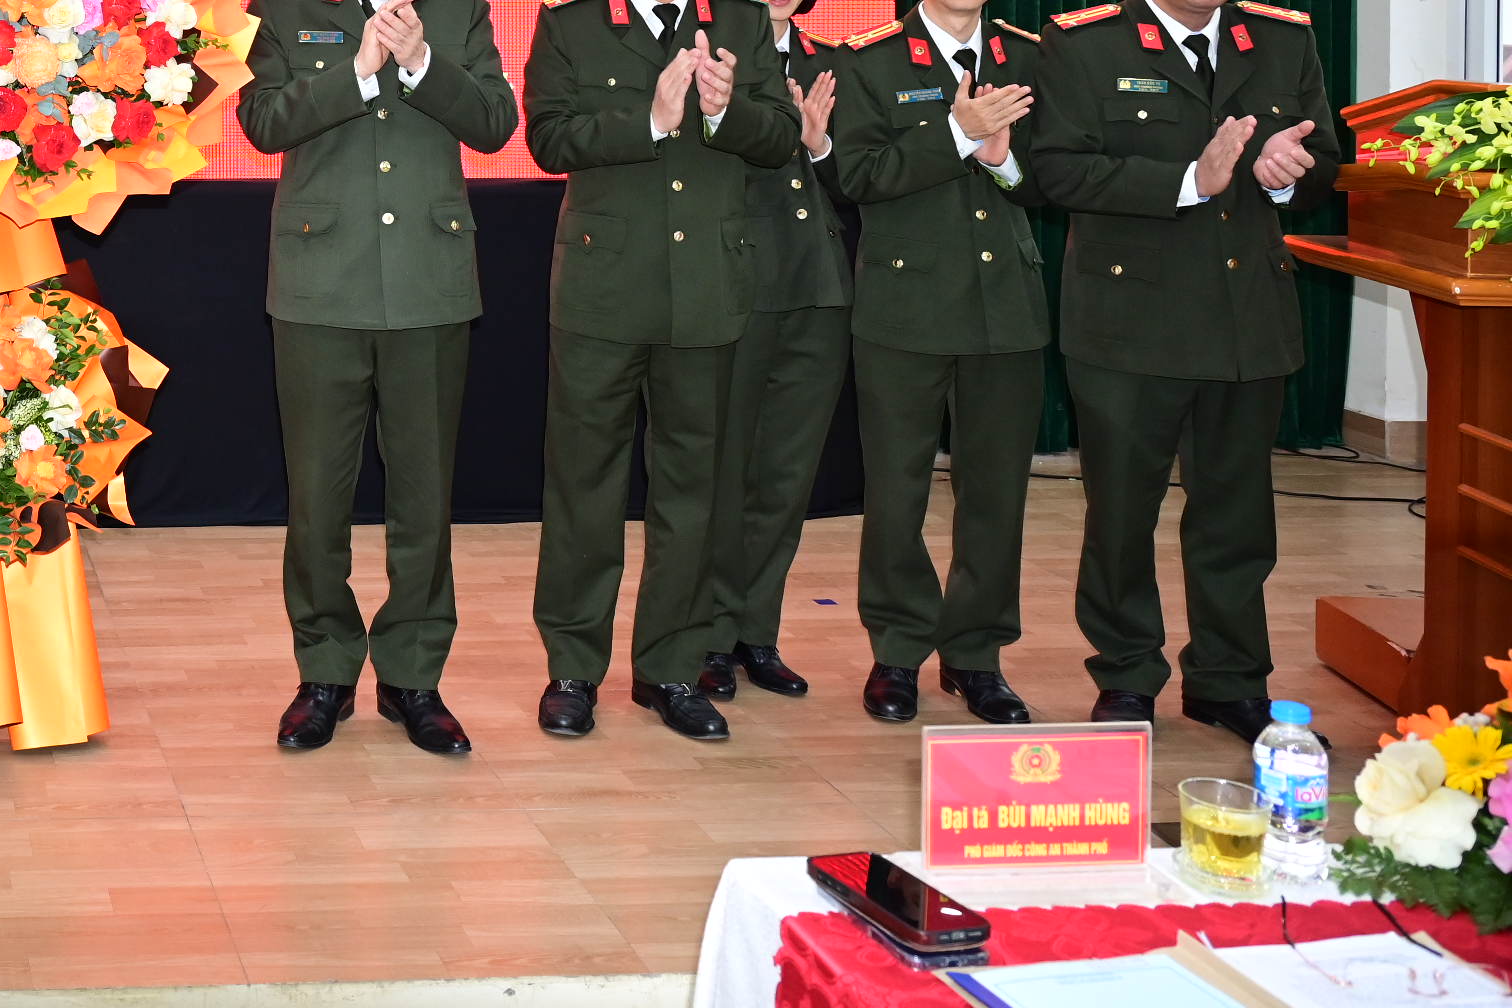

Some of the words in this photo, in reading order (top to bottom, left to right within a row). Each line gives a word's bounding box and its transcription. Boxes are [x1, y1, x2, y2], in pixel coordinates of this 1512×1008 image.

[941, 805, 968, 834] Đại
[972, 805, 989, 829] tá
[998, 800, 1026, 828] BÙI
[1030, 803, 1080, 832] MẠNH
[1085, 798, 1130, 826] HÙNG
